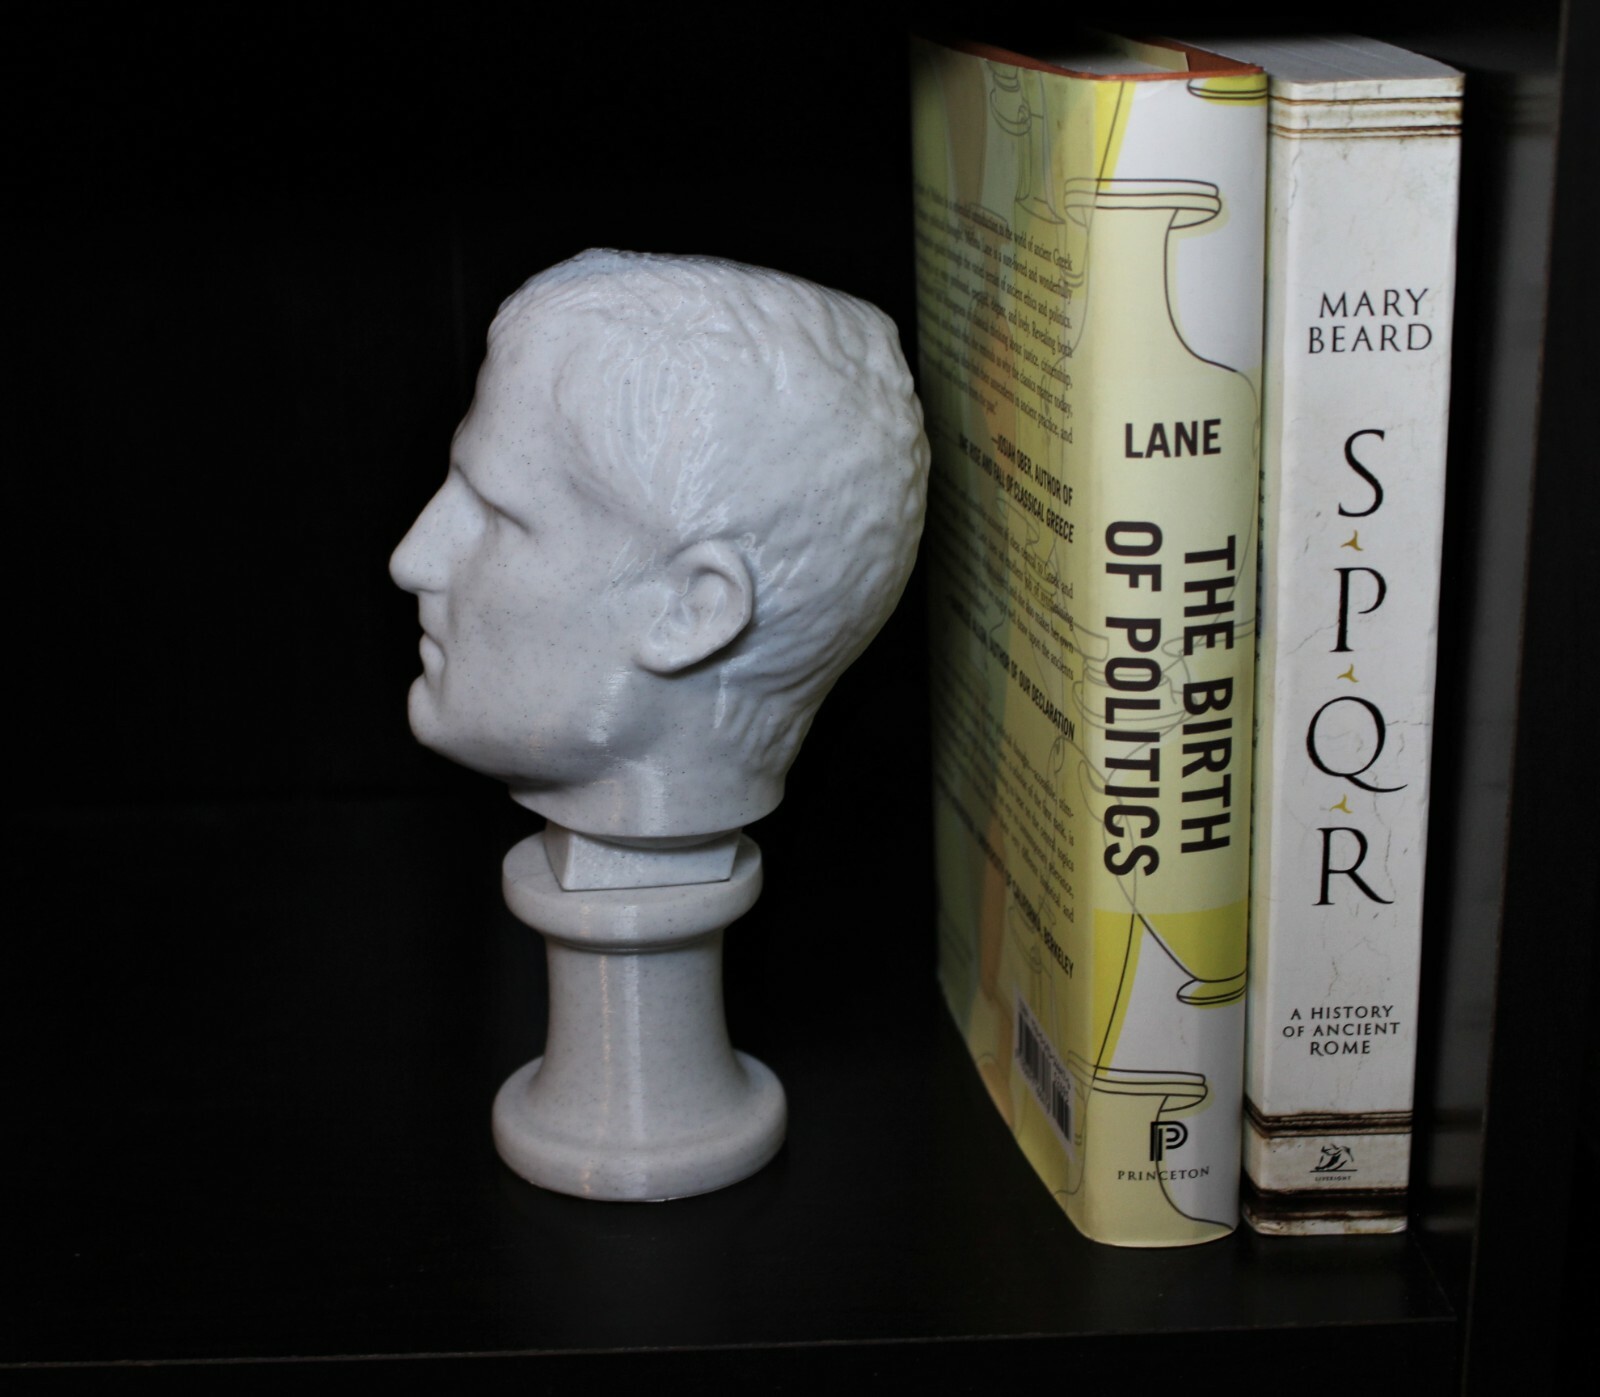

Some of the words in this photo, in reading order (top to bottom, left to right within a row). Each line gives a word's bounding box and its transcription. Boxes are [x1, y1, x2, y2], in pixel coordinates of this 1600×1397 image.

[1013, 233, 1026, 249] world
[1033, 245, 1051, 261] ancient
[1052, 249, 1072, 271] Greek
[1006, 284, 1022, 301] ancient
[1023, 292, 1037, 310] ethics
[1048, 308, 1072, 329] politics.
[1038, 276, 1072, 303] wonderfully
[1319, 288, 1429, 319] MARY
[1009, 338, 1022, 355] about
[1031, 322, 1055, 351] Revealing
[1056, 337, 1072, 358] both
[1308, 324, 1434, 355] BEARD
[1019, 371, 1036, 392] classics
[1036, 382, 1053, 403] matter
[1053, 395, 1072, 418] today,
[1020, 402, 1037, 420] ancient
[1037, 412, 1059, 436] practice,
[1059, 429, 1072, 444] and
[1124, 418, 1222, 459] LANE
[1016, 451, 1033, 477] OBER,
[1034, 467, 1061, 499] AUTHOR
[1062, 486, 1073, 505] OF
[1337, 429, 1386, 518] S
[992, 463, 1004, 488] FALL
[1005, 475, 1014, 494] OF
[1013, 483, 1044, 521] CLASSICAL
[1045, 510, 1074, 543] GREECE
[1104, 520, 1163, 593] OF
[1060, 583, 1074, 599] and
[1183, 534, 1236, 656] THE
[1329, 567, 1388, 653] P
[1050, 655, 1074, 685] ancients
[1018, 672, 1031, 695] OUR
[1030, 687, 1075, 740] DECLARATION
[1103, 616, 1162, 877] POLITICS
[1180, 676, 1234, 854] BIRTH
[1306, 696, 1409, 793] Q
[1311, 827, 1395, 906] R
[1043, 929, 1073, 977] BERKELEY
[1282, 1025, 1306, 1038] OF
[1313, 1022, 1401, 1037] ANCIENT
[1290, 1008, 1302, 1021] A
[1310, 1005, 1394, 1020] HISTORY
[1309, 1040, 1371, 1057] ROME
[1117, 1165, 1210, 1181] PRINCETON
